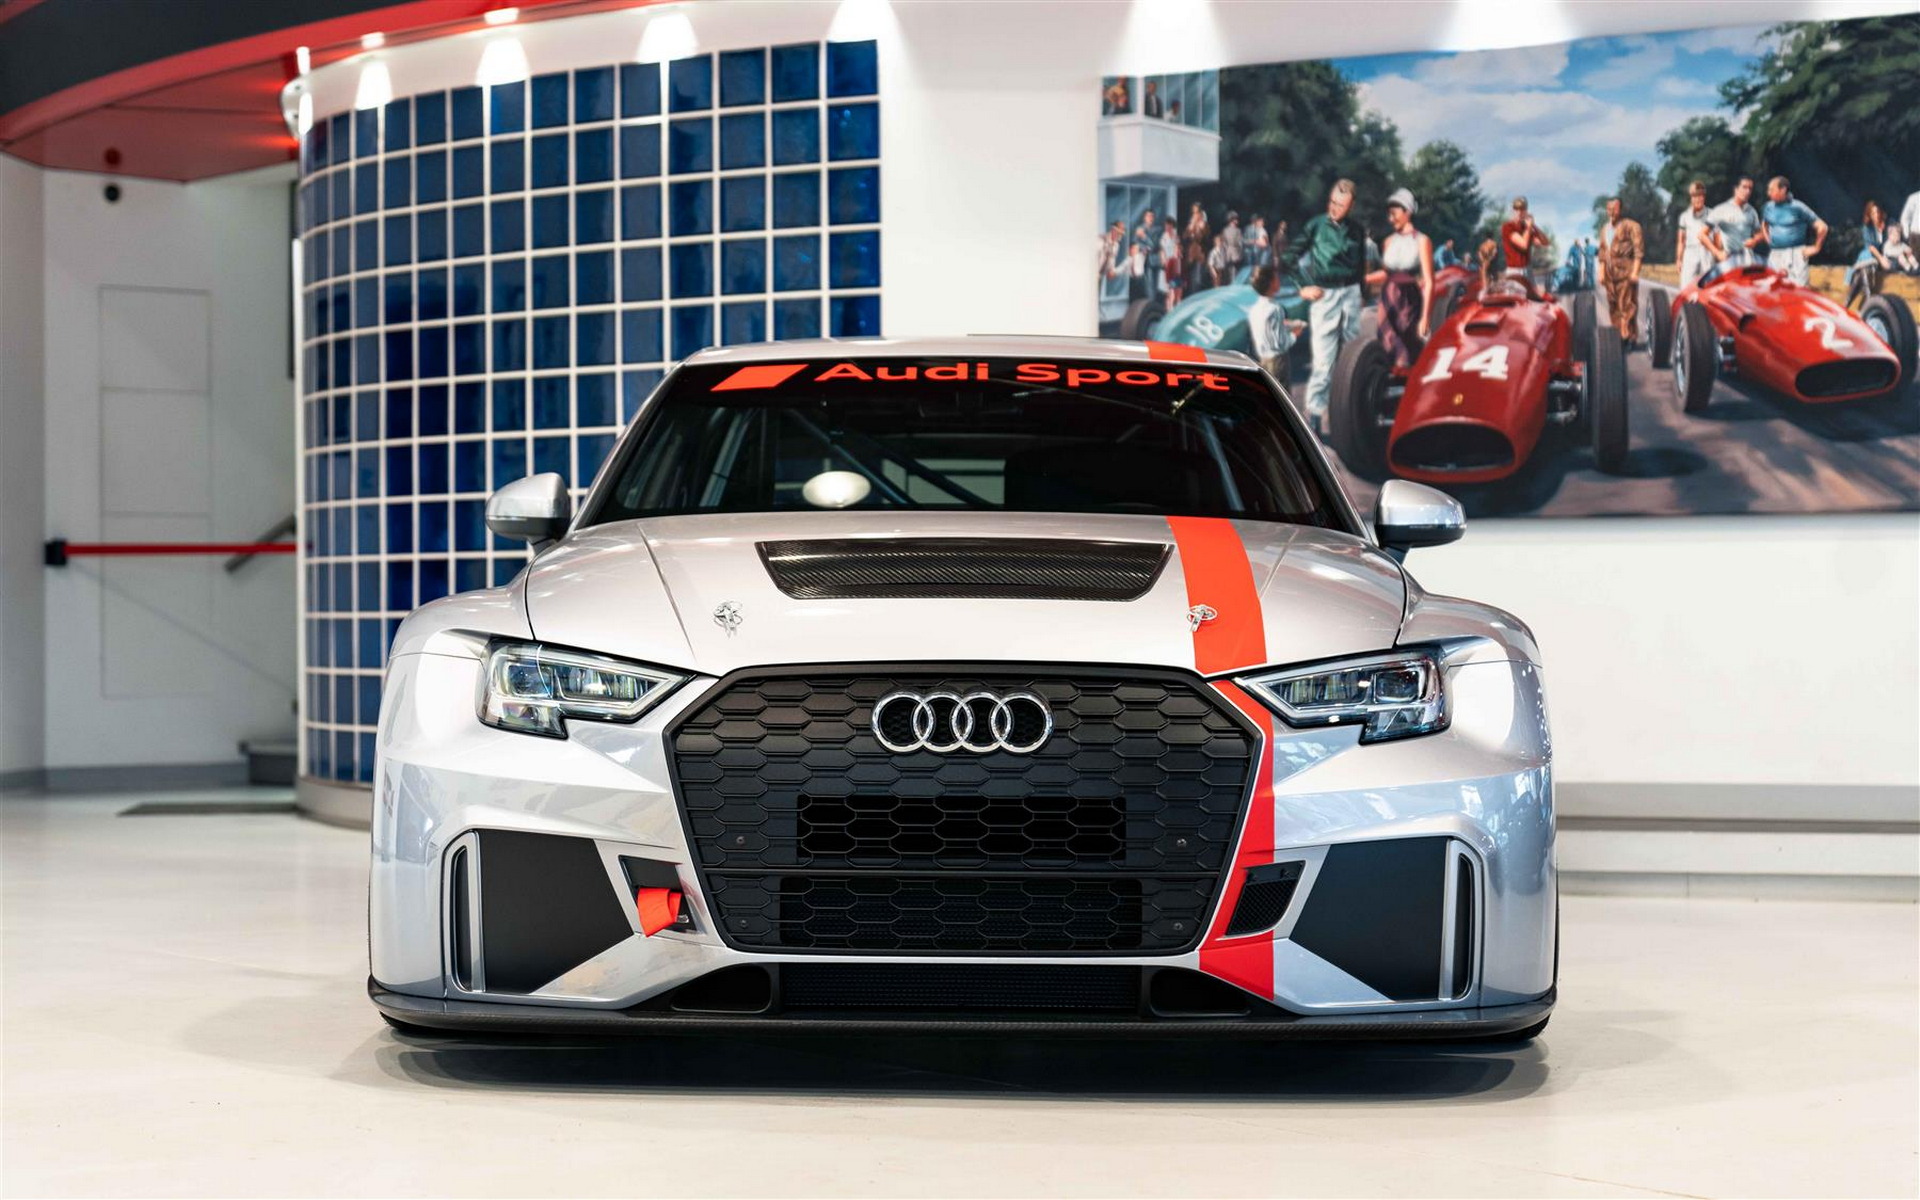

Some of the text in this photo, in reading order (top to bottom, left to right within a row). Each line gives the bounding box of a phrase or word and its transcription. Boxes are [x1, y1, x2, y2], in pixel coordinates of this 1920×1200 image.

[1185, 314, 1224, 344] 18
[1804, 317, 1854, 350] 2
[813, 362, 1230, 391] Audi Sport
[1421, 345, 1509, 384] 14
